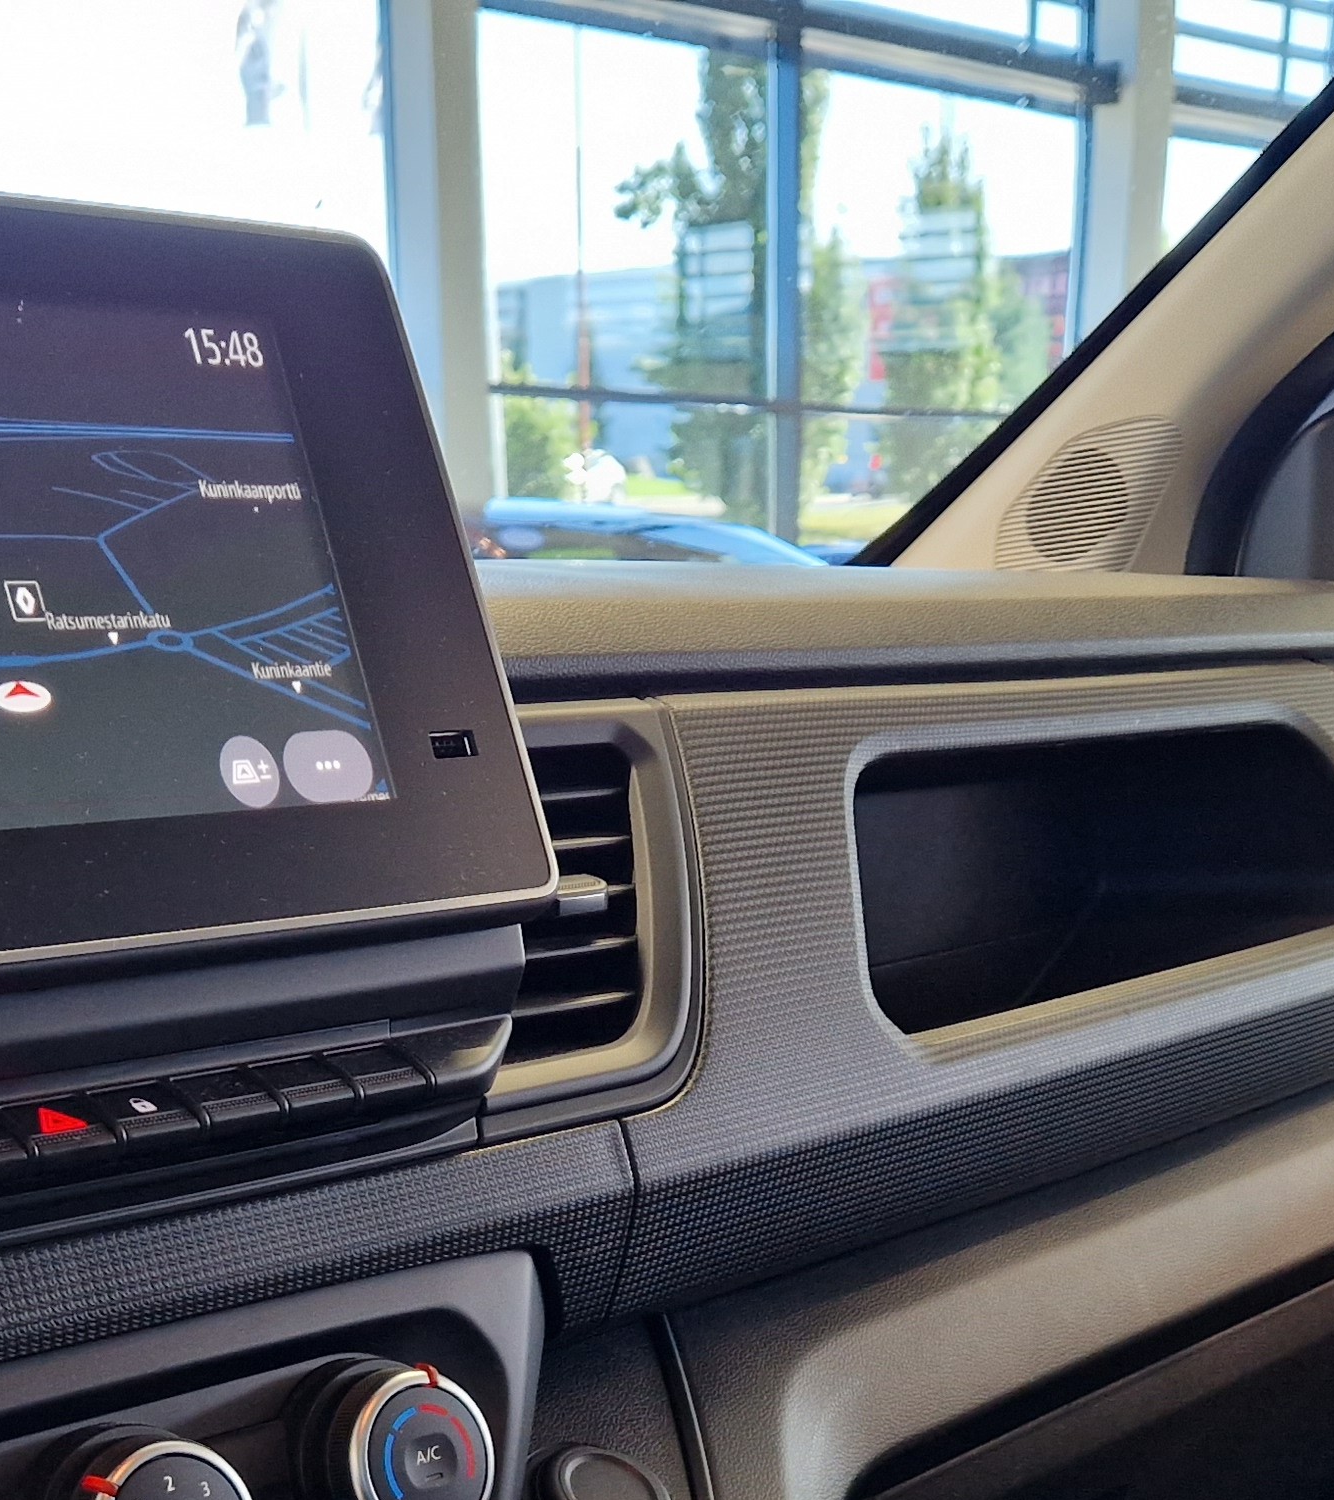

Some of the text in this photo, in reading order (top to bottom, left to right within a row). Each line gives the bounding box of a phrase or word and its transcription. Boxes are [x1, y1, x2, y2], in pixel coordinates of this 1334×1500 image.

[184, 328, 265, 368] 15:48
[197, 479, 302, 504] Kuninkaanportti
[45, 610, 172, 631] Ratsumestarinkatu
[250, 660, 333, 680] Kuninkaantie
[416, 1444, 442, 1466] A/C
[163, 1475, 176, 1492] 2
[200, 1481, 211, 1497] 3
